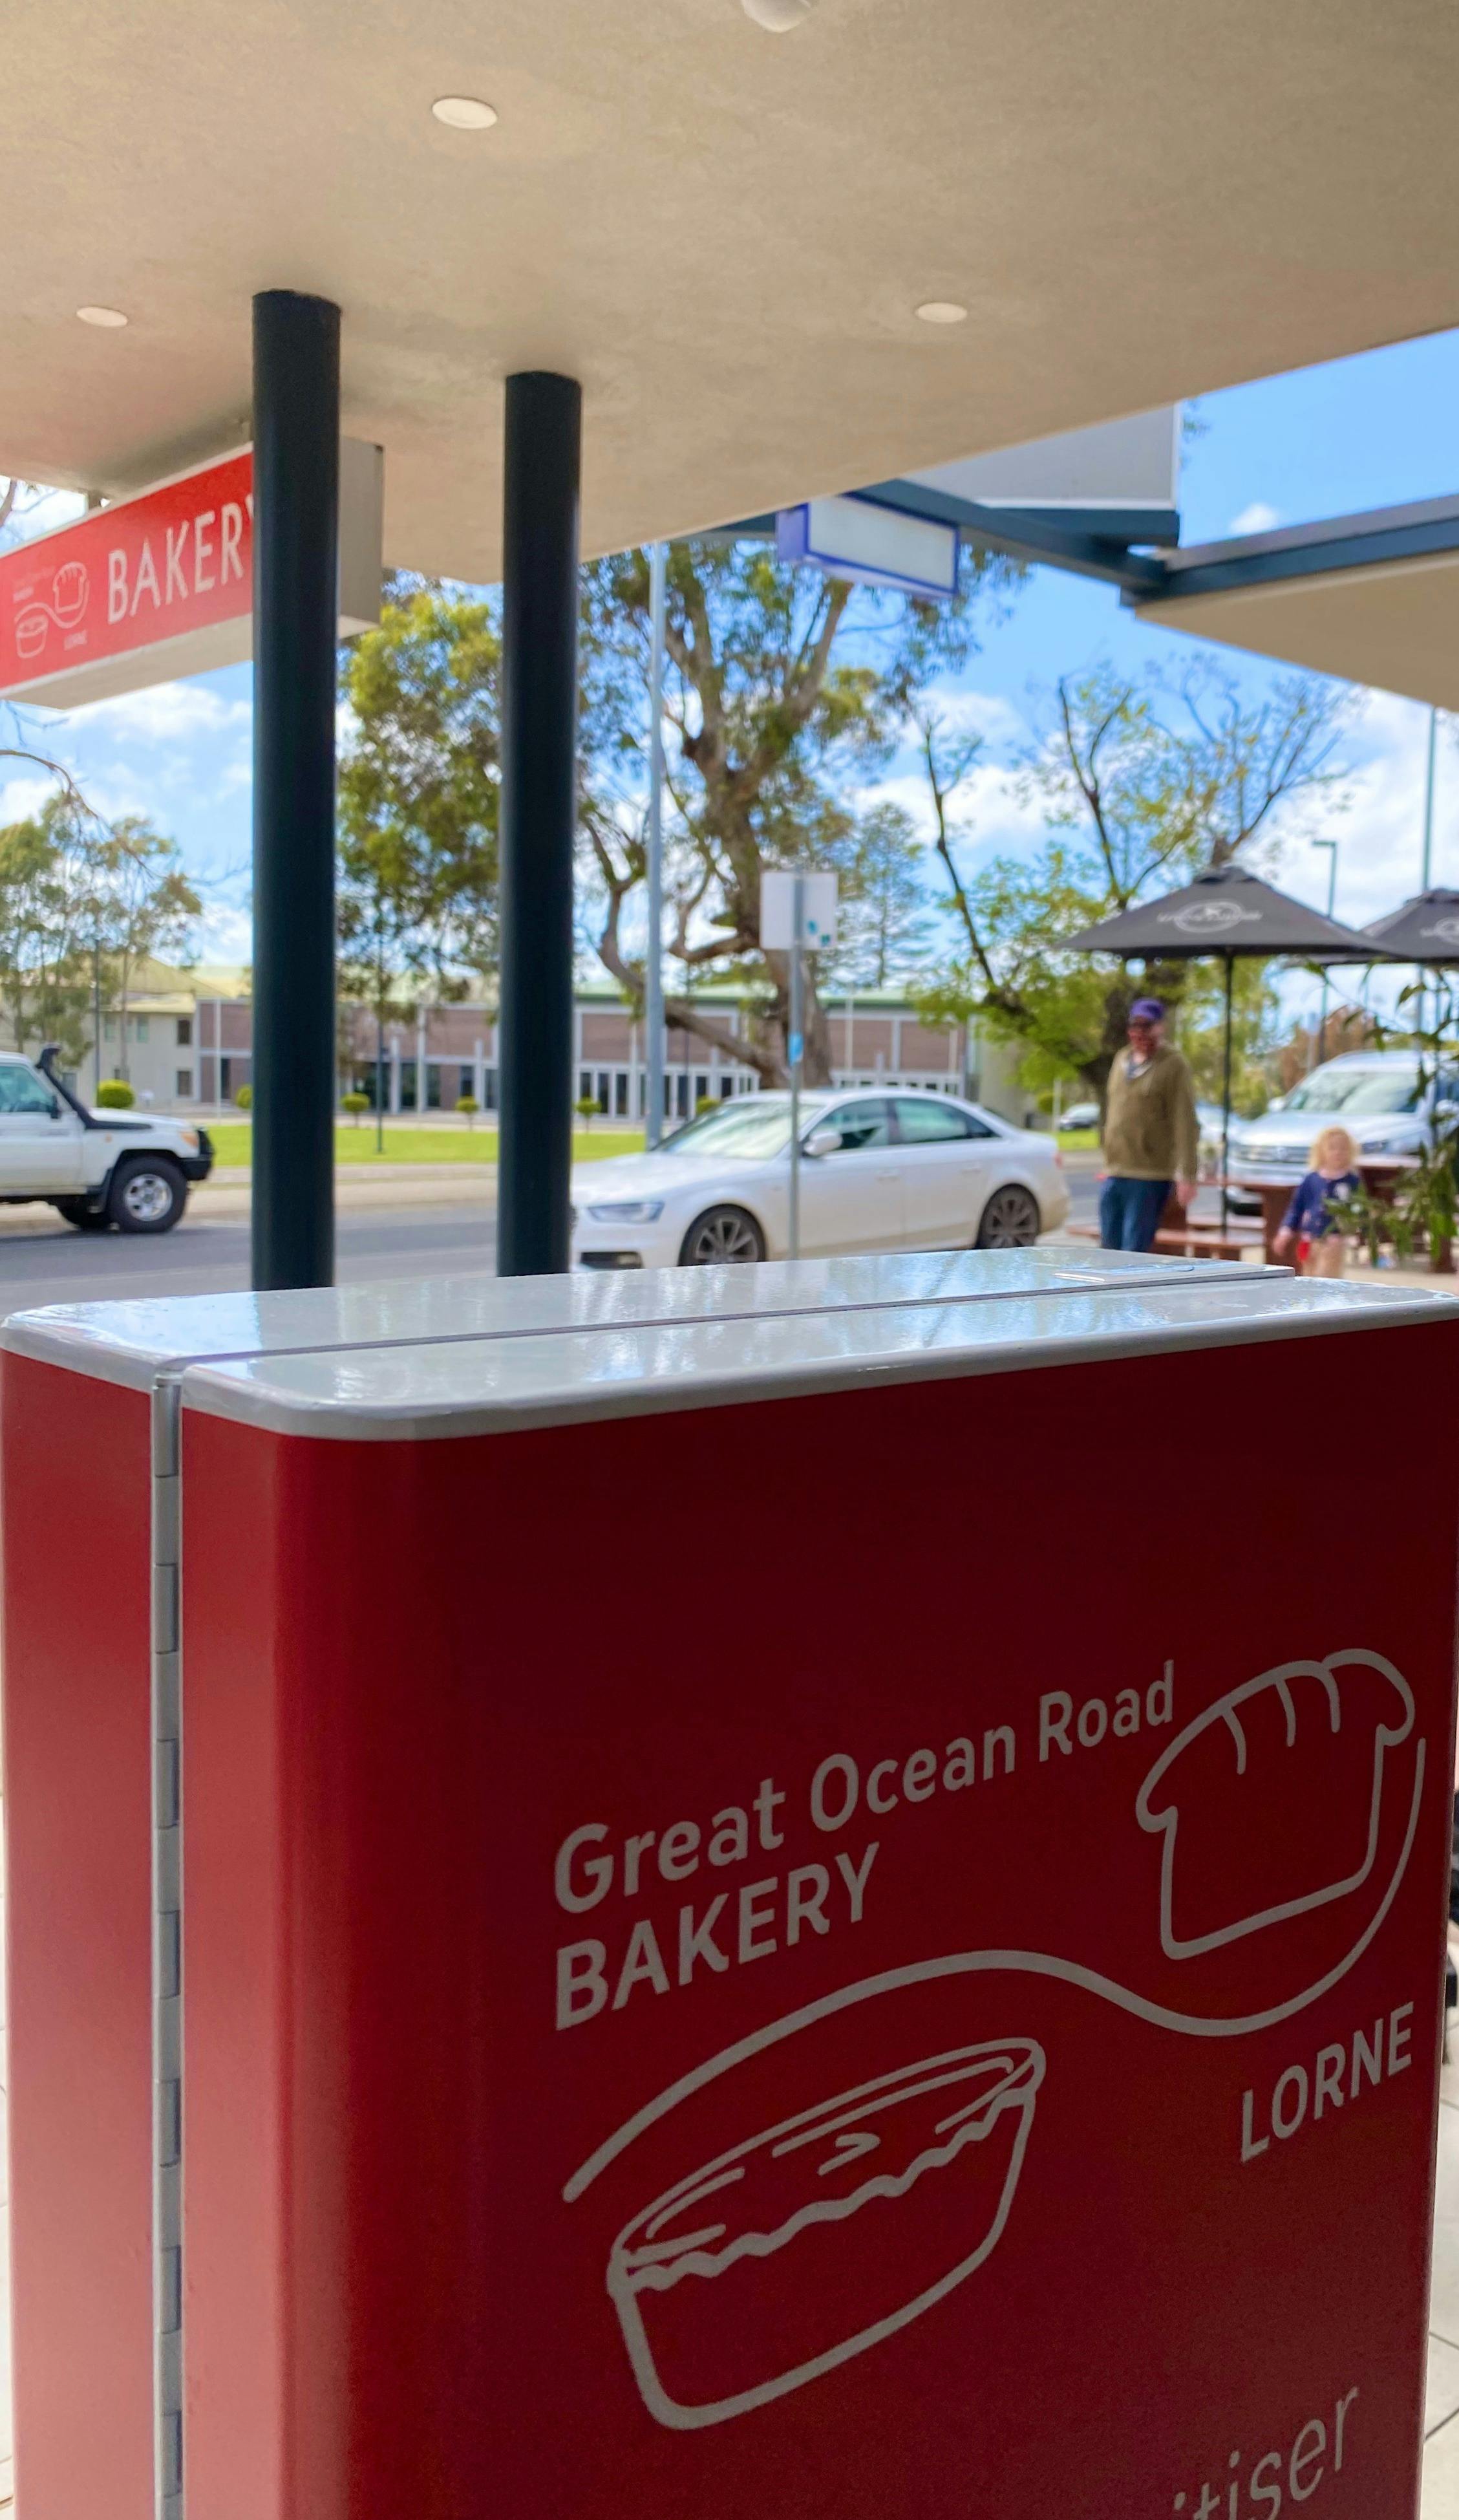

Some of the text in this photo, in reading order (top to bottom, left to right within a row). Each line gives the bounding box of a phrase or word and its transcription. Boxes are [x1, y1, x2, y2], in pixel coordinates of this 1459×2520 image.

[108, 495, 253, 624] BAKER
[555, 1660, 1173, 1914] Great Ocean Road
[555, 1844, 880, 2030] BAKERY
[1241, 2002, 1412, 2162] LORNE
